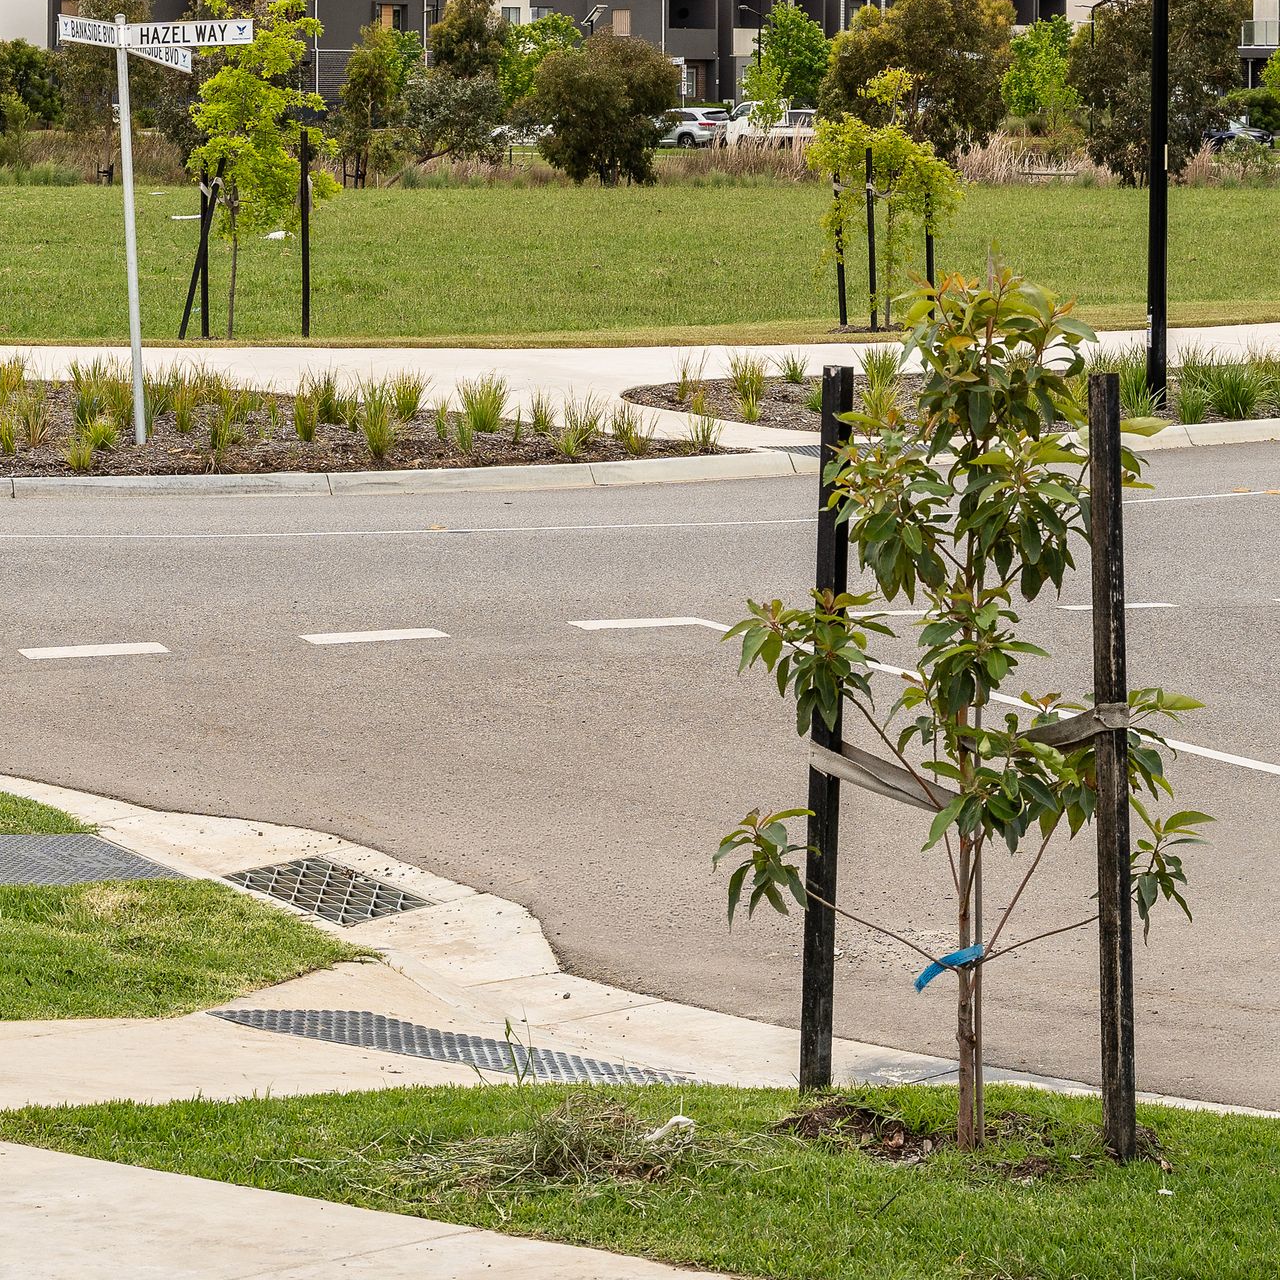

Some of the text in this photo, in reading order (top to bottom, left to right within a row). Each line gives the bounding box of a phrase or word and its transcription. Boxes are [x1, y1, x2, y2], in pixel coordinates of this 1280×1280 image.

[70, 20, 116, 44] BANKSIDE BVD
[140, 23, 228, 45] HAZEL WAY
[164, 47, 179, 65] BVD
